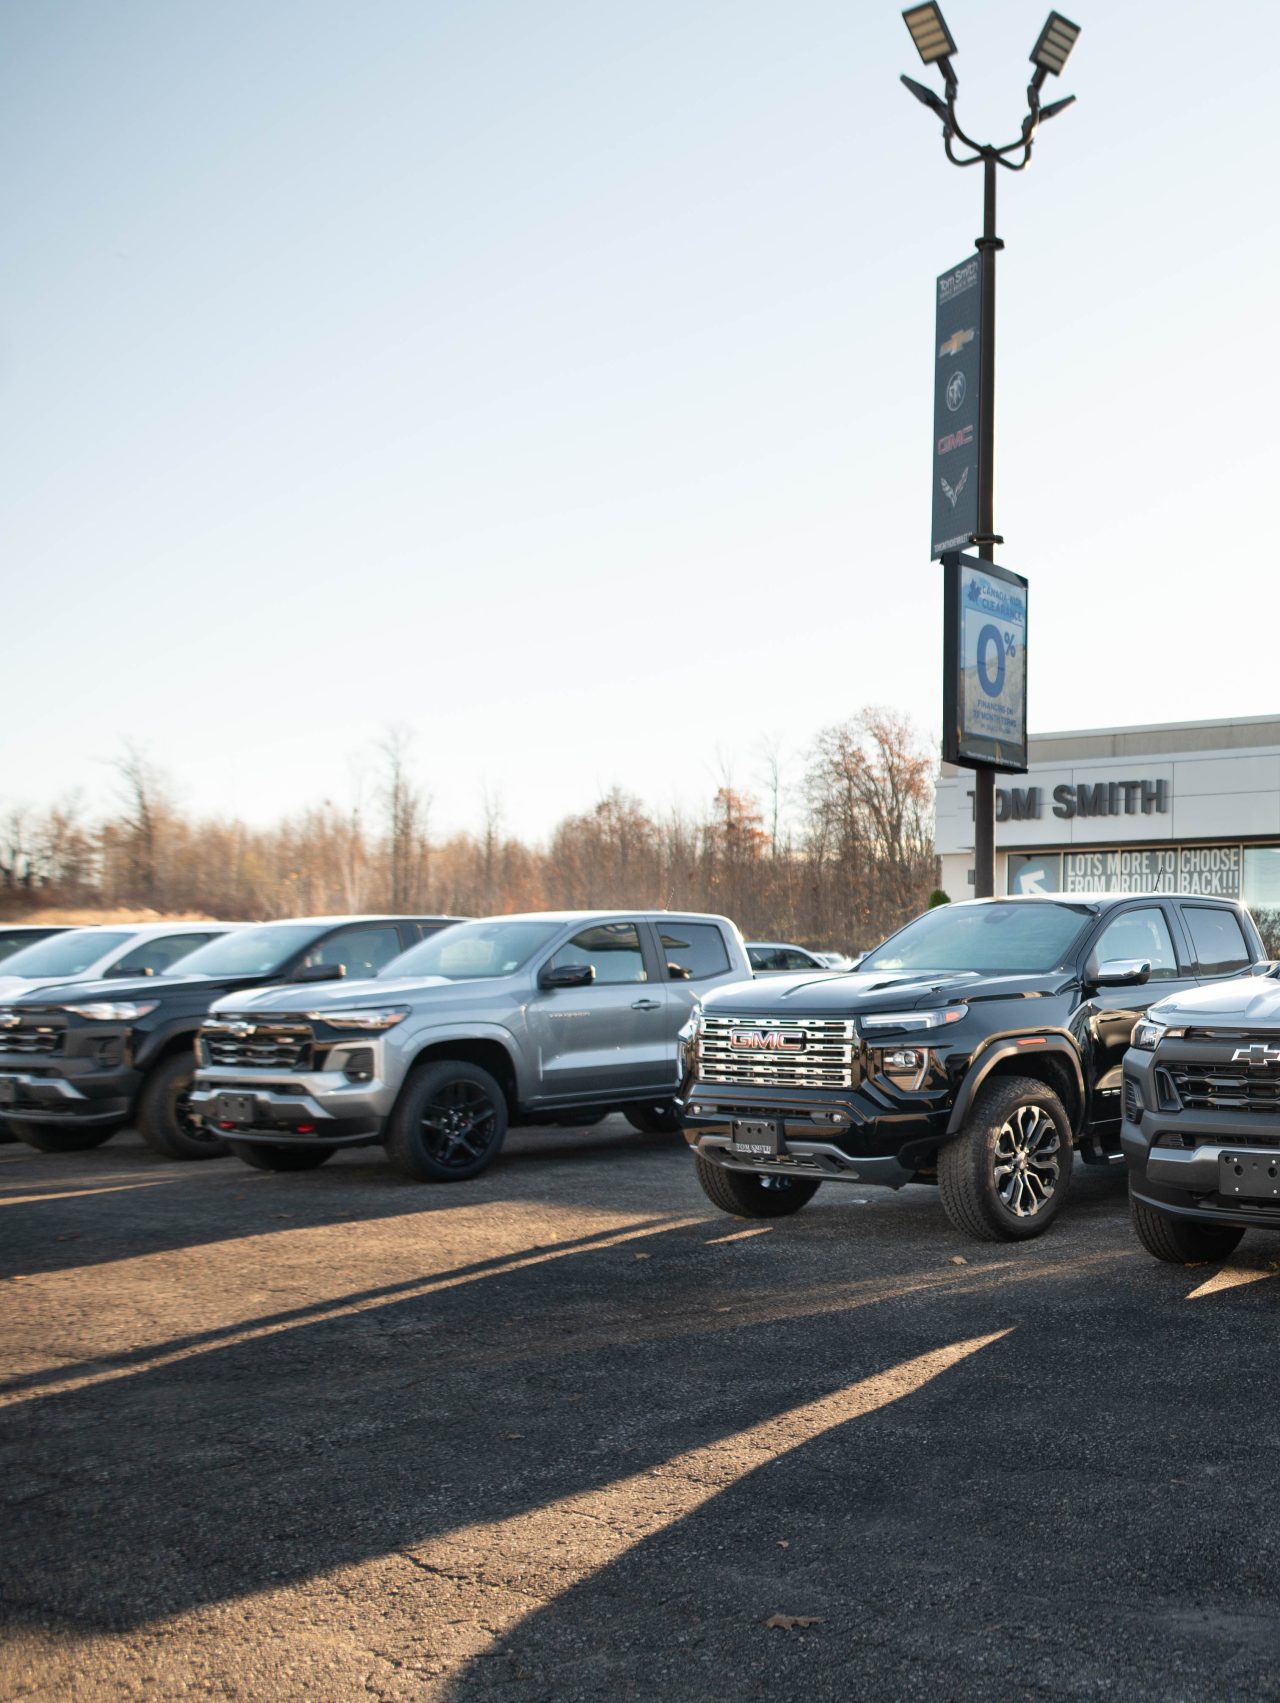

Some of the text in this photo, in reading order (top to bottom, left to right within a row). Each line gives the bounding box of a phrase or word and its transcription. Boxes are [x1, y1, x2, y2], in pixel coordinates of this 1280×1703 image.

[938, 424, 973, 455] GMC
[1053, 779, 1168, 819] SMITH
[1068, 848, 1239, 876] LOTS MORE TO CHOOSE
[1067, 871, 1239, 894] FROM AROUND BACK!!!
[731, 1030, 803, 1050] GMC
[736, 1143, 750, 1151] TOM
[751, 1144, 771, 1152] SMITH
